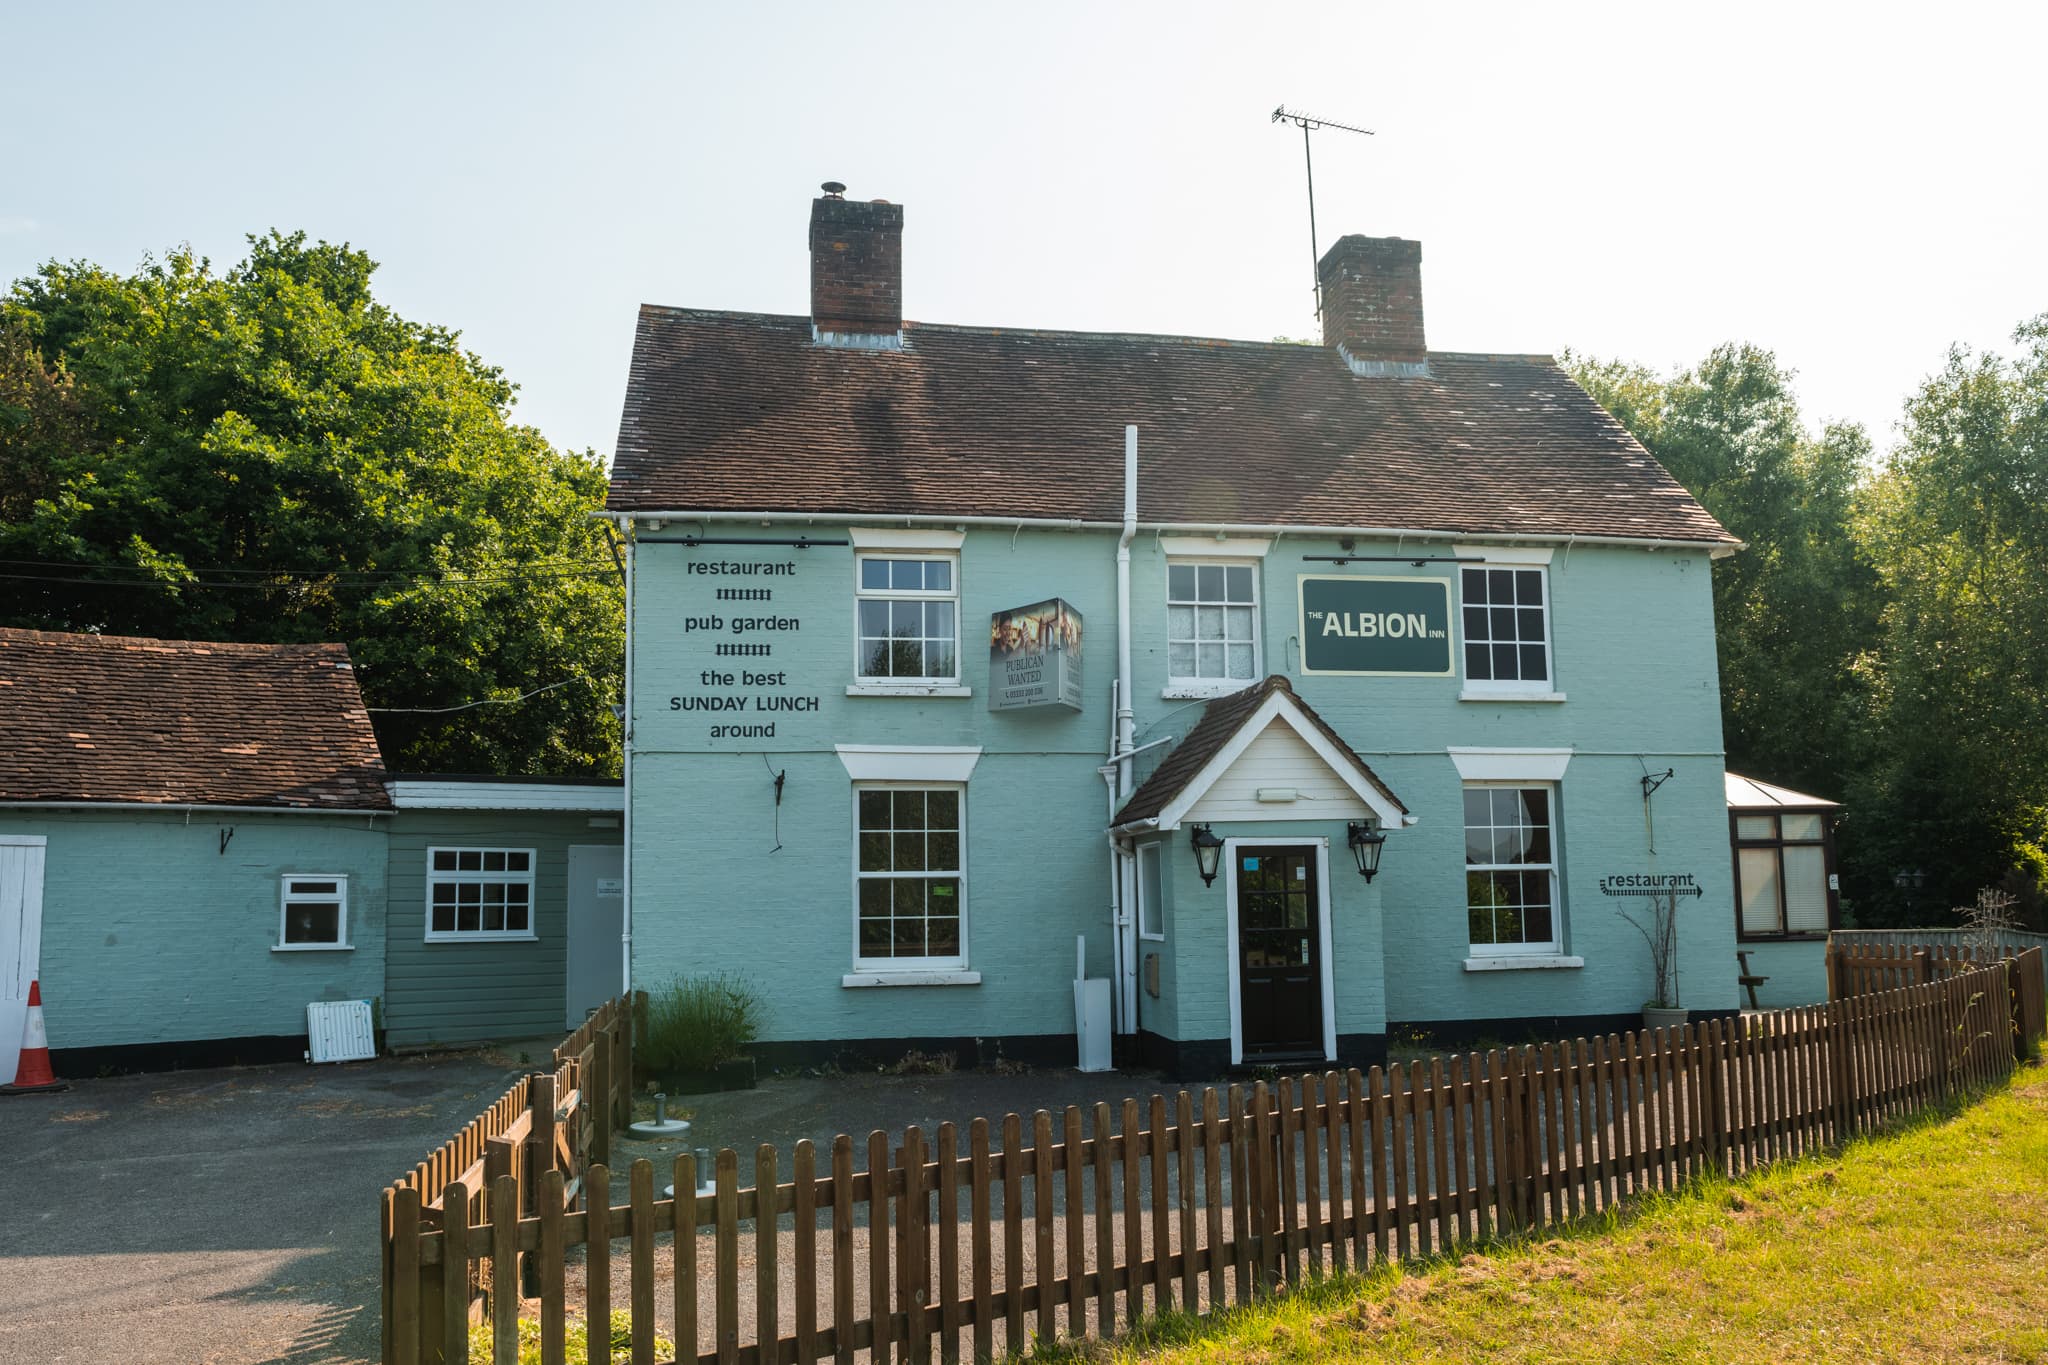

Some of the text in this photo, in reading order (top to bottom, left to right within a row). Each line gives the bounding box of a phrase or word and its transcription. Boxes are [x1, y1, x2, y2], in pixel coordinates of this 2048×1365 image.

[687, 560, 796, 576] restaurant
[685, 614, 800, 634] pub garden
[1307, 611, 1446, 639] THE ALBION INN
[1006, 655, 1044, 673] PUBLICAN
[700, 670, 787, 686] the best
[1007, 670, 1042, 686] WANTED
[670, 696, 819, 711] SUNDAY LUNCH
[710, 722, 776, 738] around
[1608, 873, 1695, 887] restaurant
